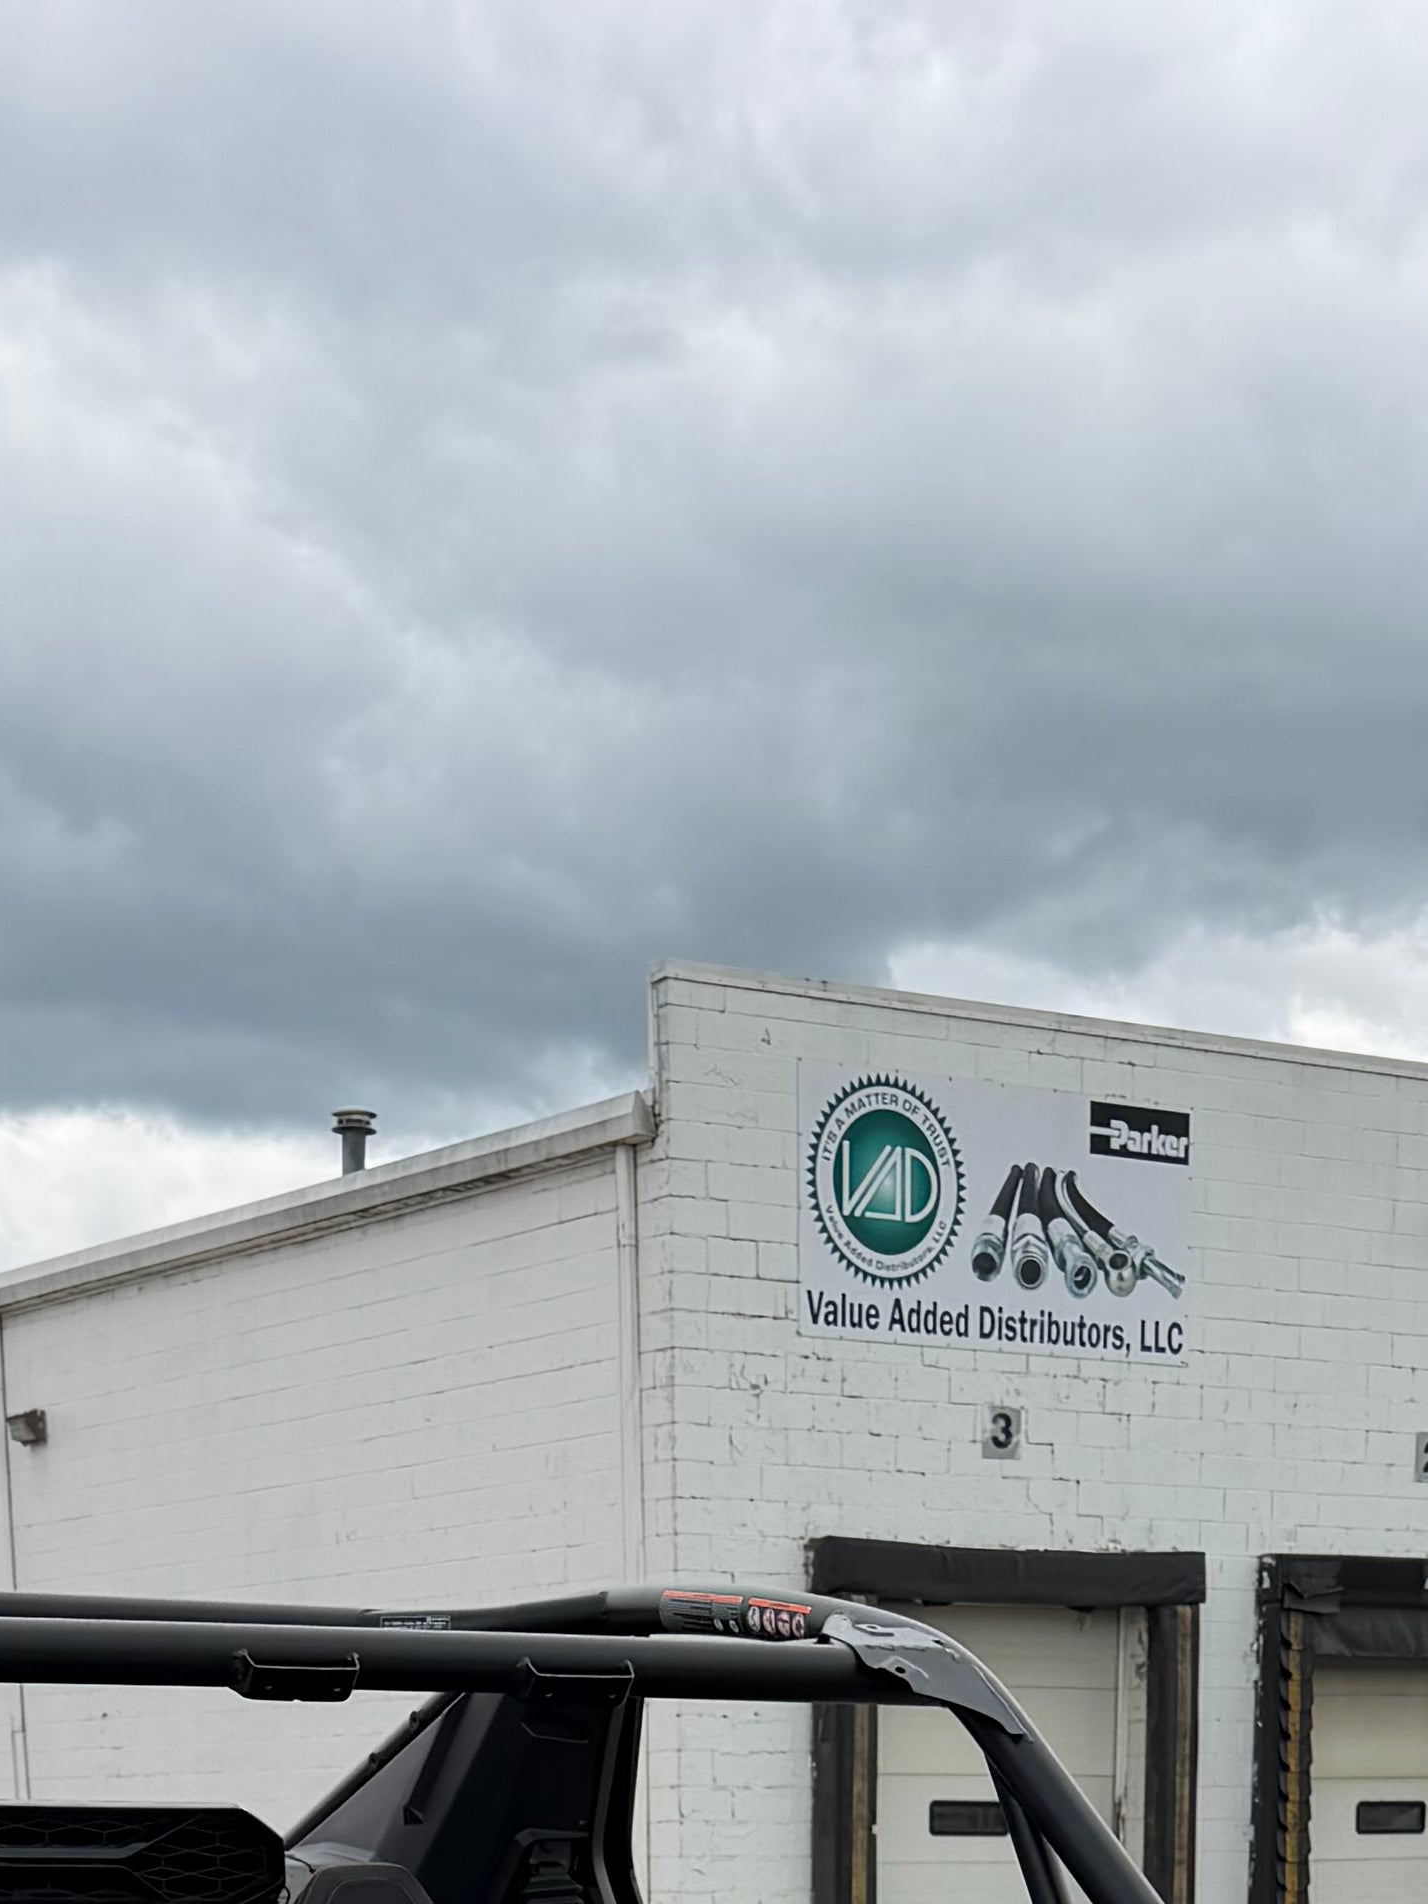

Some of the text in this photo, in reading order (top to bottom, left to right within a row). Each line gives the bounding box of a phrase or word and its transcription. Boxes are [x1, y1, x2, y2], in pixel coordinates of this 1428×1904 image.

[844, 1092, 899, 1119] MATTER
[901, 1099, 921, 1116] OF
[921, 1114, 951, 1168] TRUST
[1109, 1119, 1188, 1158] Parker
[806, 1289, 1184, 1358] Value Added Distributors, LLC
[992, 1412, 1013, 1449] 3
